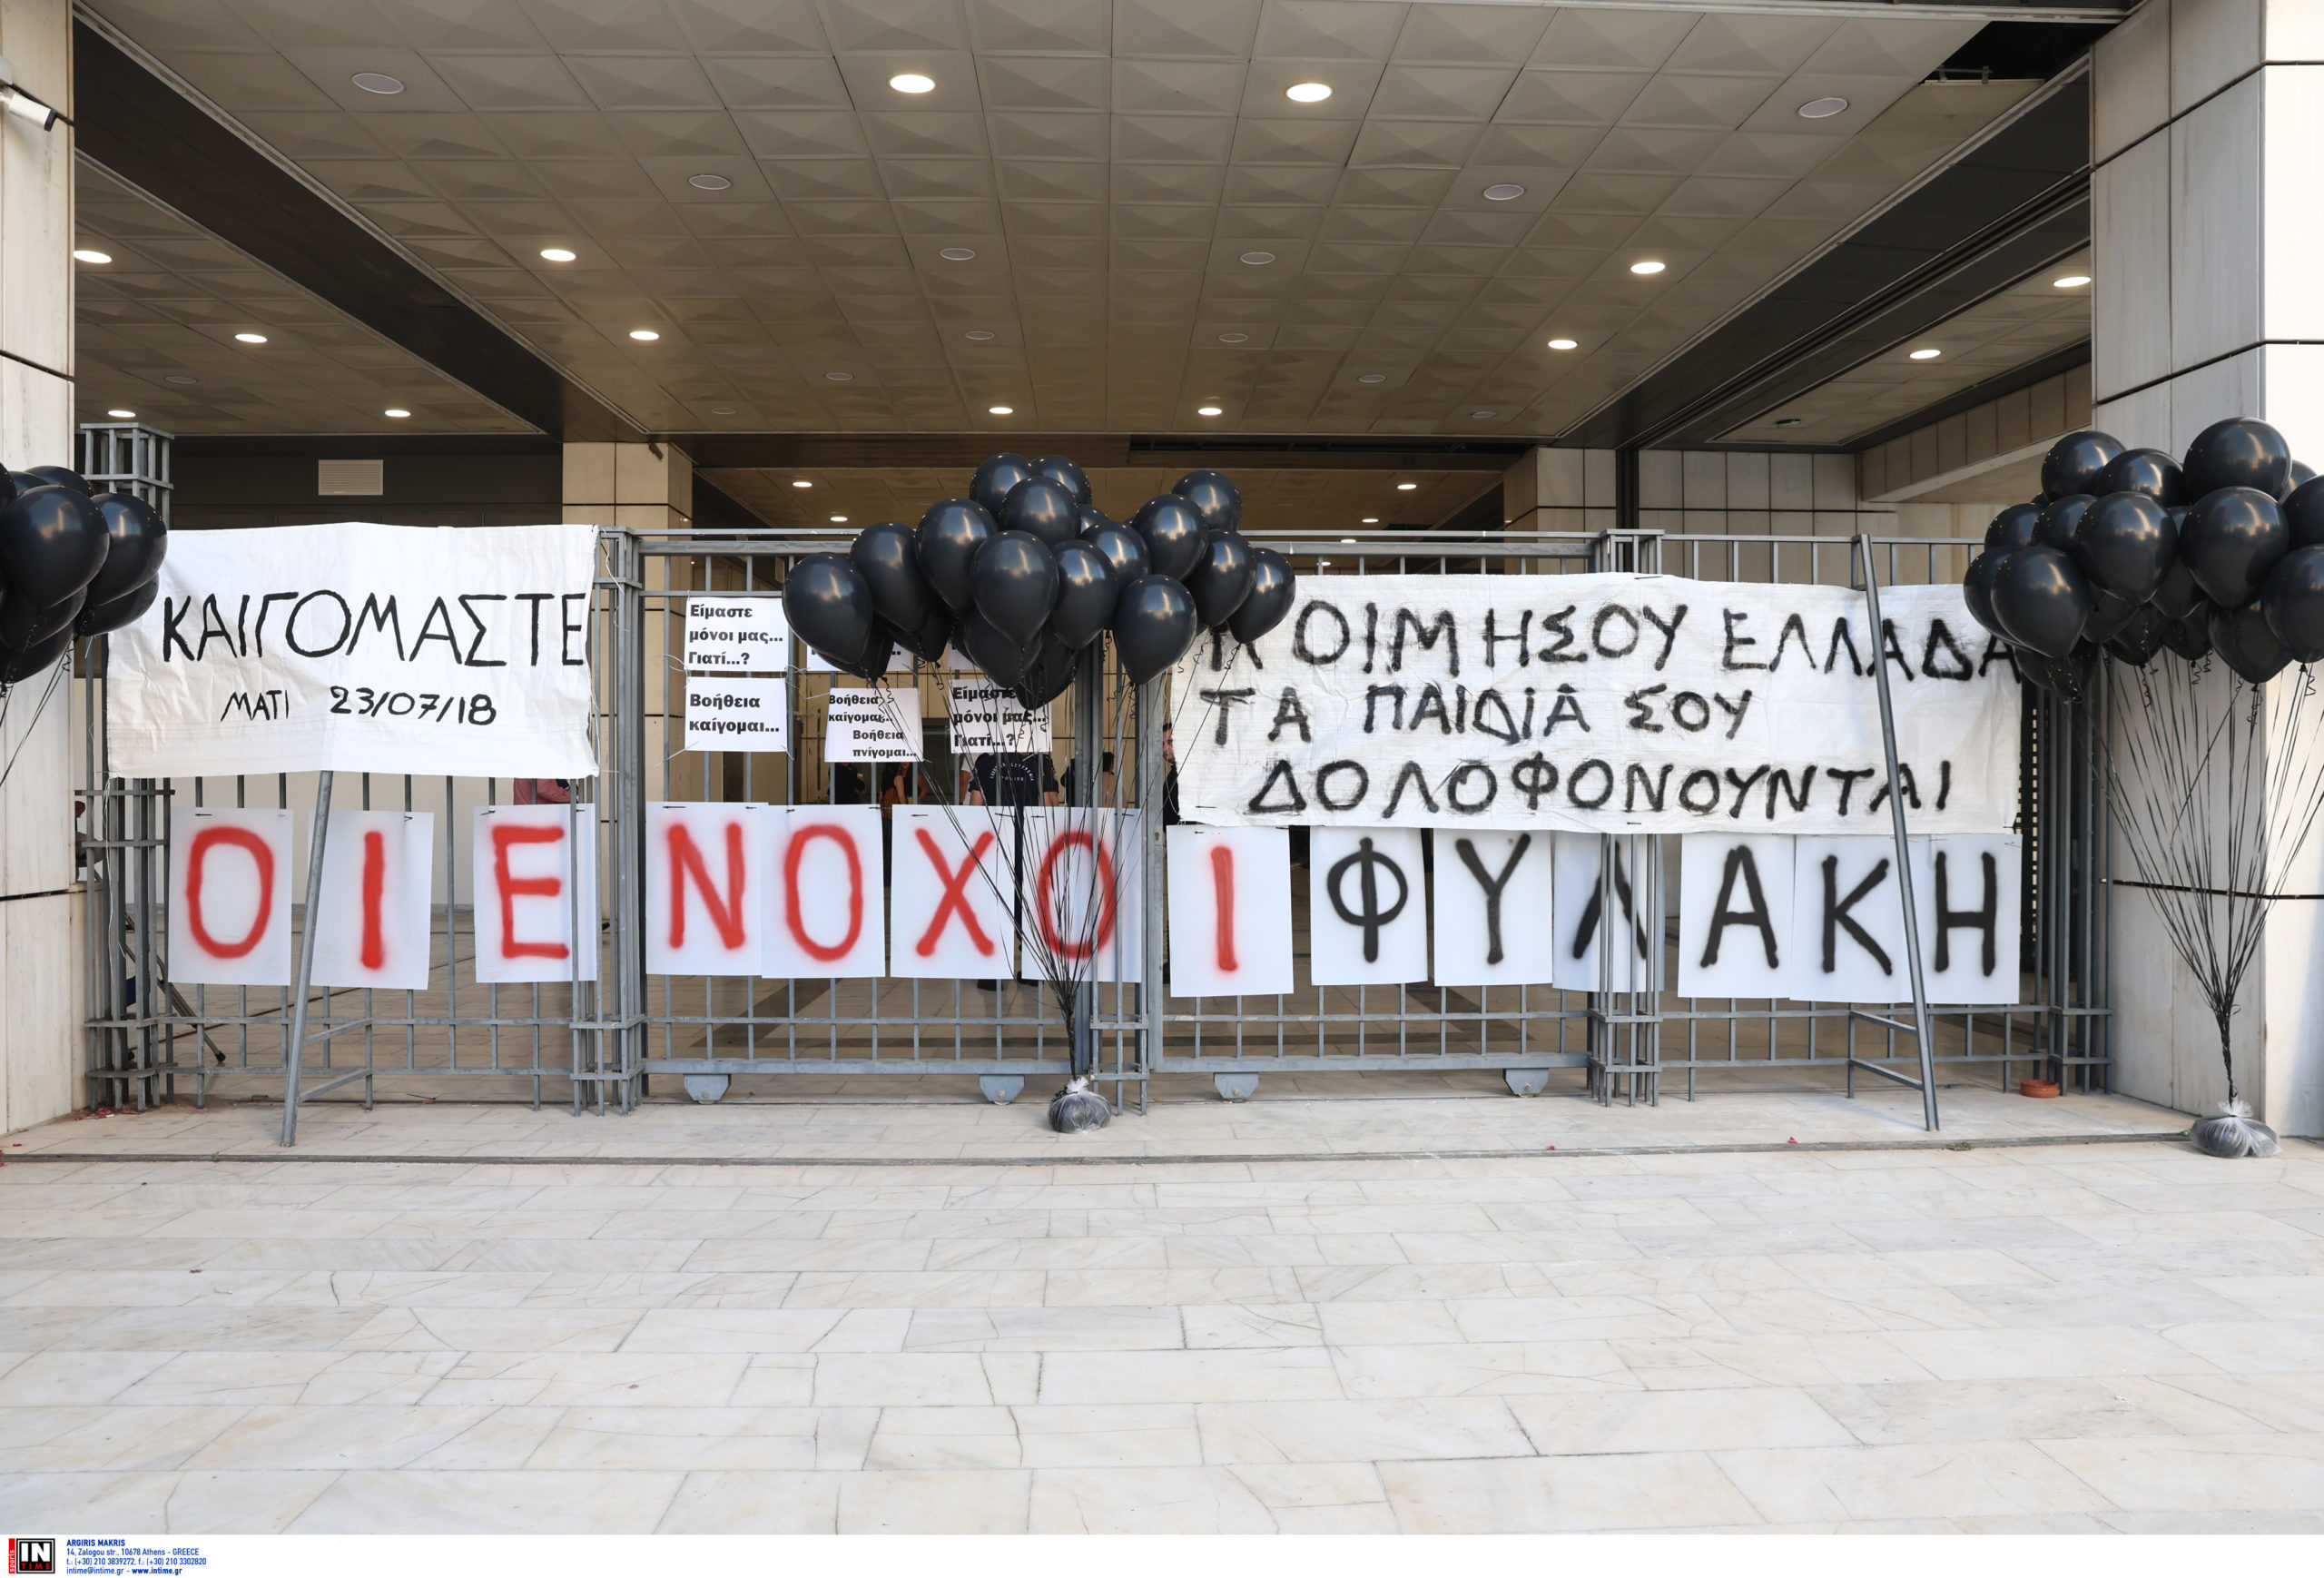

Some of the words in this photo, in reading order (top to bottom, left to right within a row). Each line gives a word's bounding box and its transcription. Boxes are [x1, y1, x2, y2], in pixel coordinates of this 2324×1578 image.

[690, 604, 753, 619] Είμαστε
[163, 589, 586, 667] ΚΑΙΓΟΜΑΣΤΕ
[689, 627, 734, 644] μόνοι
[738, 630, 783, 644] μας...
[1722, 606, 2022, 684] ΕΛΛΑΔΑ
[688, 651, 751, 666] Γιατί...?
[221, 689, 290, 722] ΜΑΤΙ
[330, 686, 497, 725] 23/07/18
[689, 693, 761, 710] Βοήθεια
[829, 694, 879, 706] Βοήθεια
[828, 711, 893, 724] καίγομαι...
[953, 709, 998, 726] μόνοι
[1199, 685, 1312, 746] ΤΑ
[1364, 683, 1591, 745] ΠΑΙΔΙΑ
[1623, 683, 1752, 740] ΣΟΥ
[689, 717, 780, 735] καίγομαι...
[852, 729, 904, 742] Βοήθεια
[954, 732, 1015, 748] Γιατί...?
[852, 746, 916, 759] πνίγομαι...
[1247, 753, 1952, 821] ΔΟΛΟΦΟΝΟΥΝΤΑΙ
[1325, 833, 1998, 978] ΦΥΛΑΚΗ
